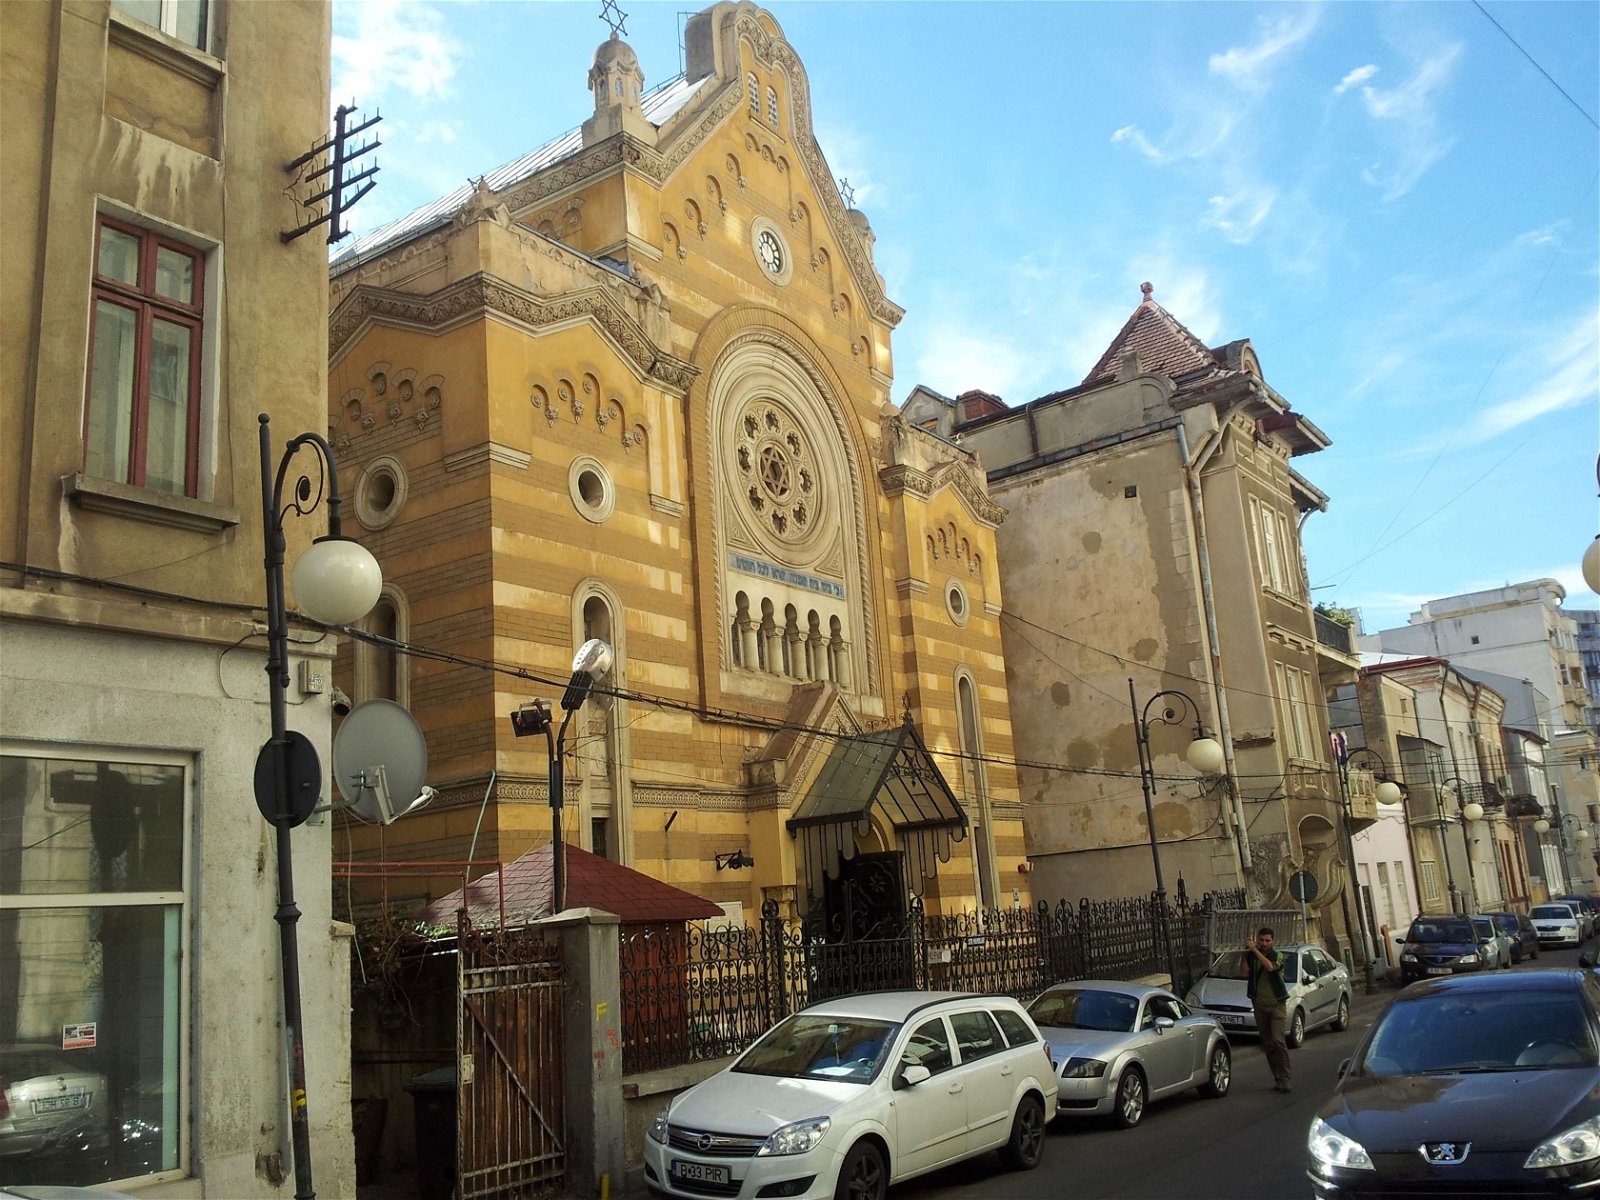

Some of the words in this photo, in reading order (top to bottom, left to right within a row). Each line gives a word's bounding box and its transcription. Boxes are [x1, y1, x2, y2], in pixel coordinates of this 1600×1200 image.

[680, 1164, 688, 1177] B
[690, 1166, 702, 1179] 33
[705, 1168, 722, 1182] PIR
